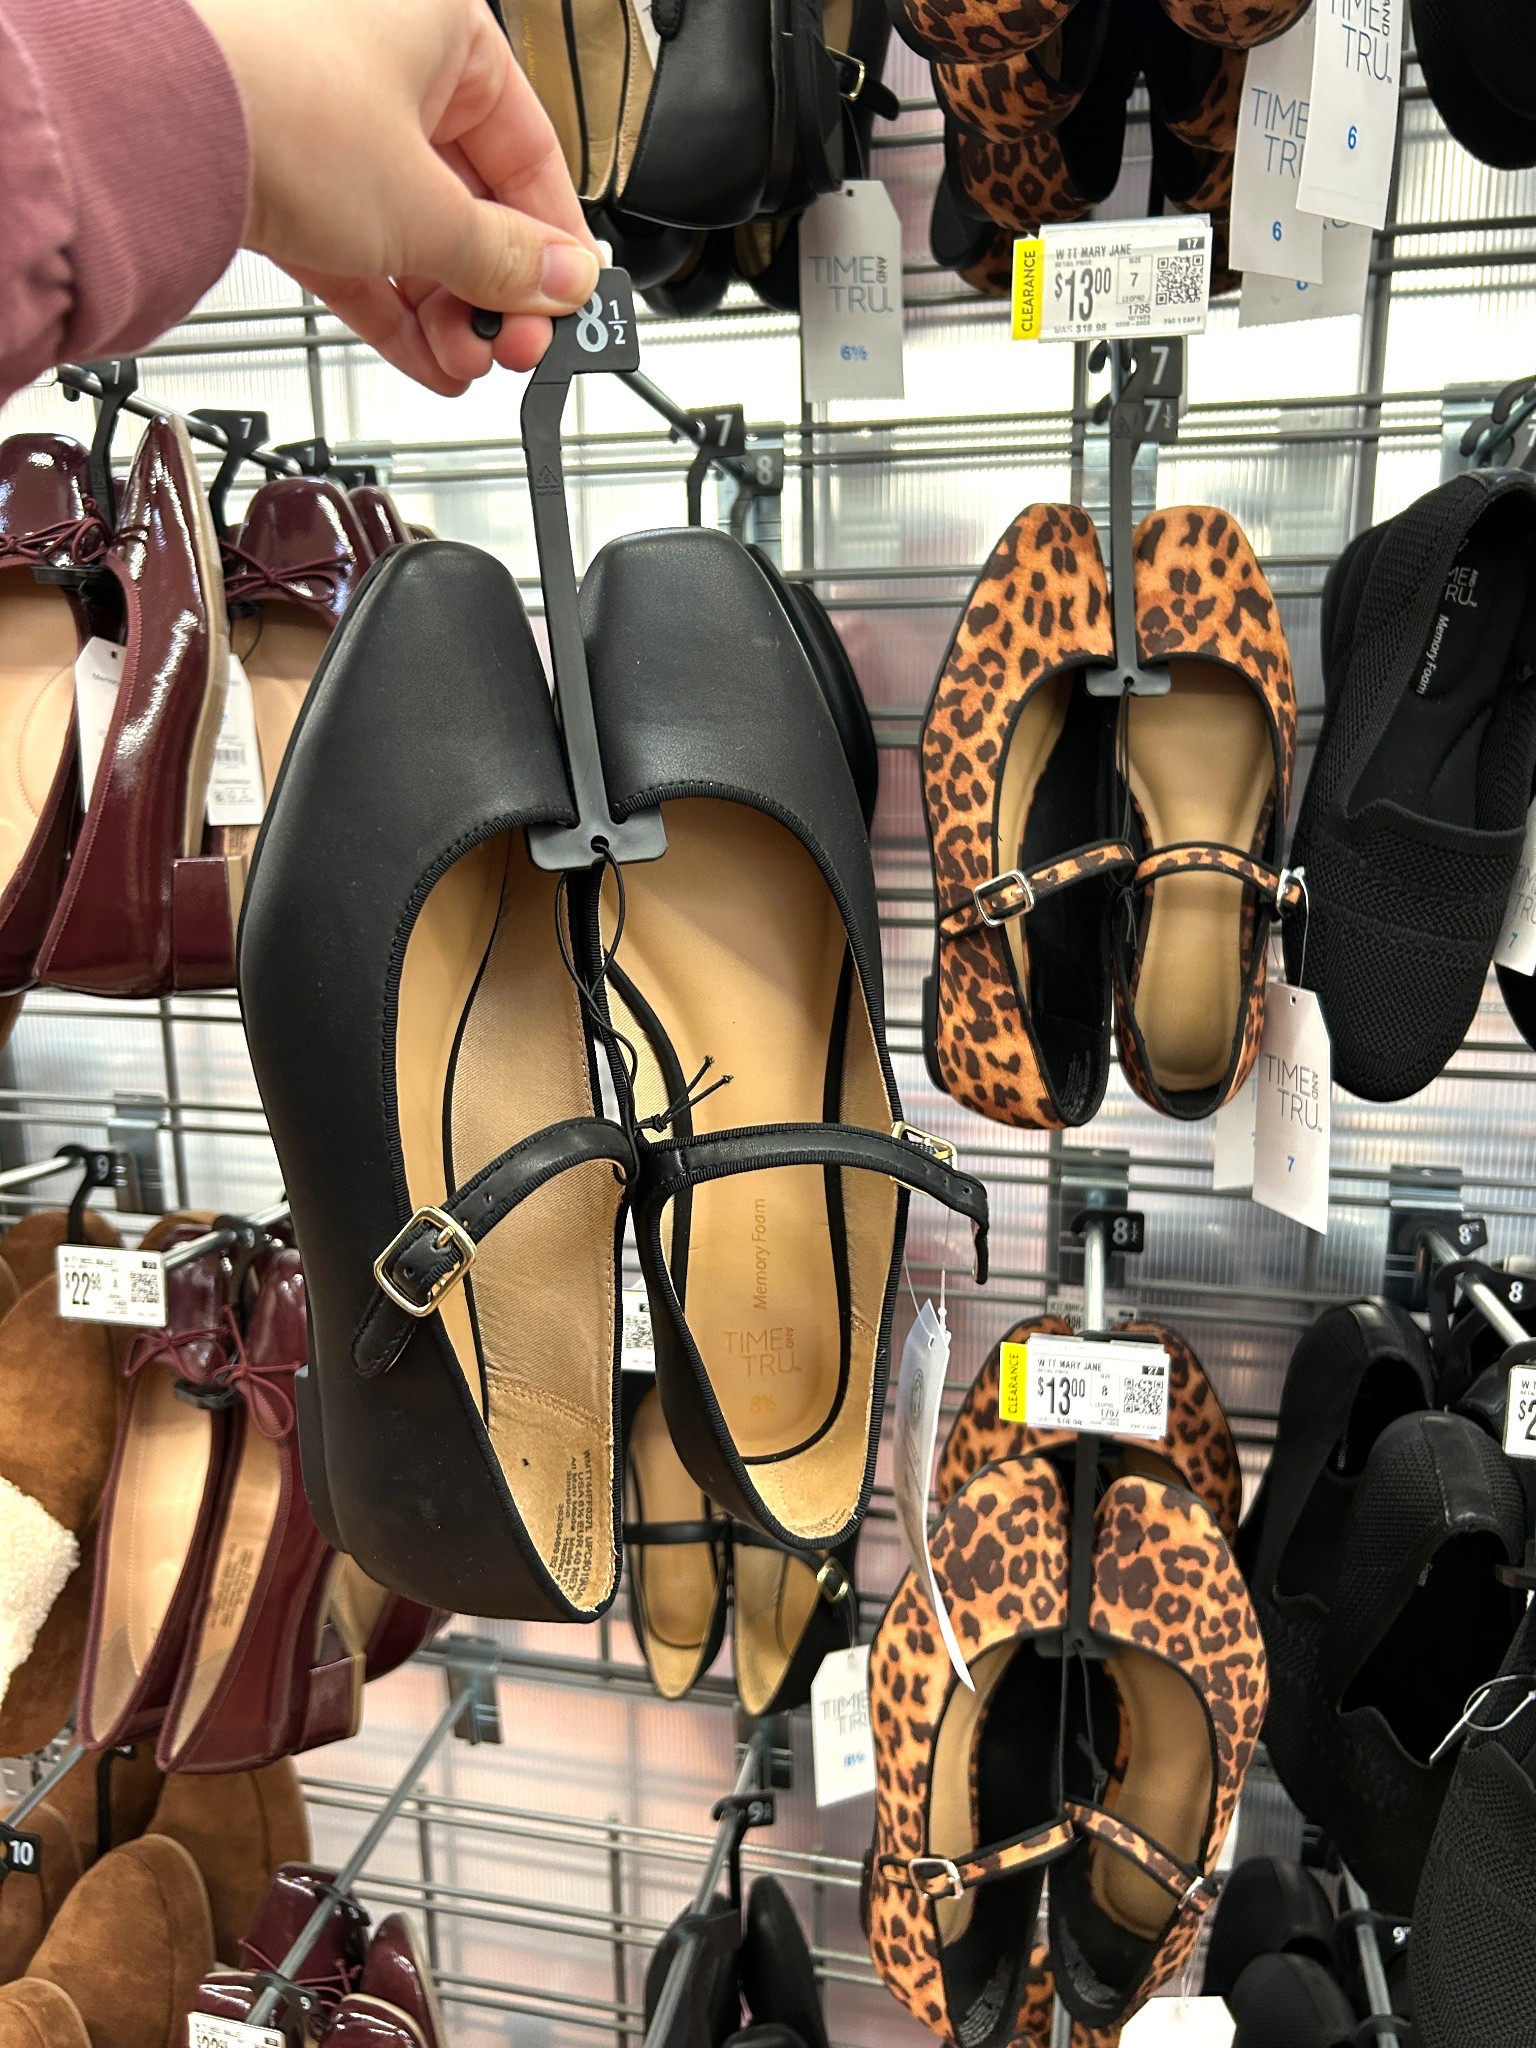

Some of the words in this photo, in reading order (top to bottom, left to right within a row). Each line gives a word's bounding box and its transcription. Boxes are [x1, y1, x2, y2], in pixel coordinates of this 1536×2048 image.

[1347, 125, 1358, 150] 6
[1264, 134, 1304, 179] TR
[1185, 238, 1198, 249] 17
[1271, 220, 1283, 242] 6
[1055, 249, 1066, 260] W
[1080, 246, 1107, 258] MARY
[1108, 243, 1132, 257] JANE
[807, 255, 876, 285] TIME
[1130, 272, 1140, 287] 7
[1021, 250, 1037, 332] CLEARANCE
[1128, 303, 1151, 316] 1795
[110, 360, 121, 385] 7
[1150, 345, 1170, 386] 7
[239, 417, 253, 439] 7
[715, 413, 733, 447] 7
[756, 455, 774, 486] 8
[1444, 582, 1476, 607] RU
[1426, 613, 1450, 662] Memory
[1415, 661, 1437, 696] Foam
[1508, 930, 1519, 950] 7
[1264, 1053, 1312, 1098] TIME
[1311, 1067, 1320, 1101] AND
[1287, 1155, 1296, 1173] 7
[751, 1198, 766, 1242] Foam
[752, 1246, 771, 1310] Memory
[1508, 1280, 1524, 1304] 8
[722, 1327, 784, 1354] TIME
[1037, 1358, 1046, 1367] W
[1059, 1360, 1081, 1370] MARY
[1083, 1361, 1102, 1372] JANE
[1007, 1353, 1019, 1415] CLEARANCE
[1101, 1385, 1108, 1396] 8
[1521, 1379, 1531, 1389] W
[577, 1471, 585, 1499] USA
[576, 1520, 585, 1548] EUR
[573, 1550, 582, 1565] 40
[9, 1839, 35, 1867] 10
